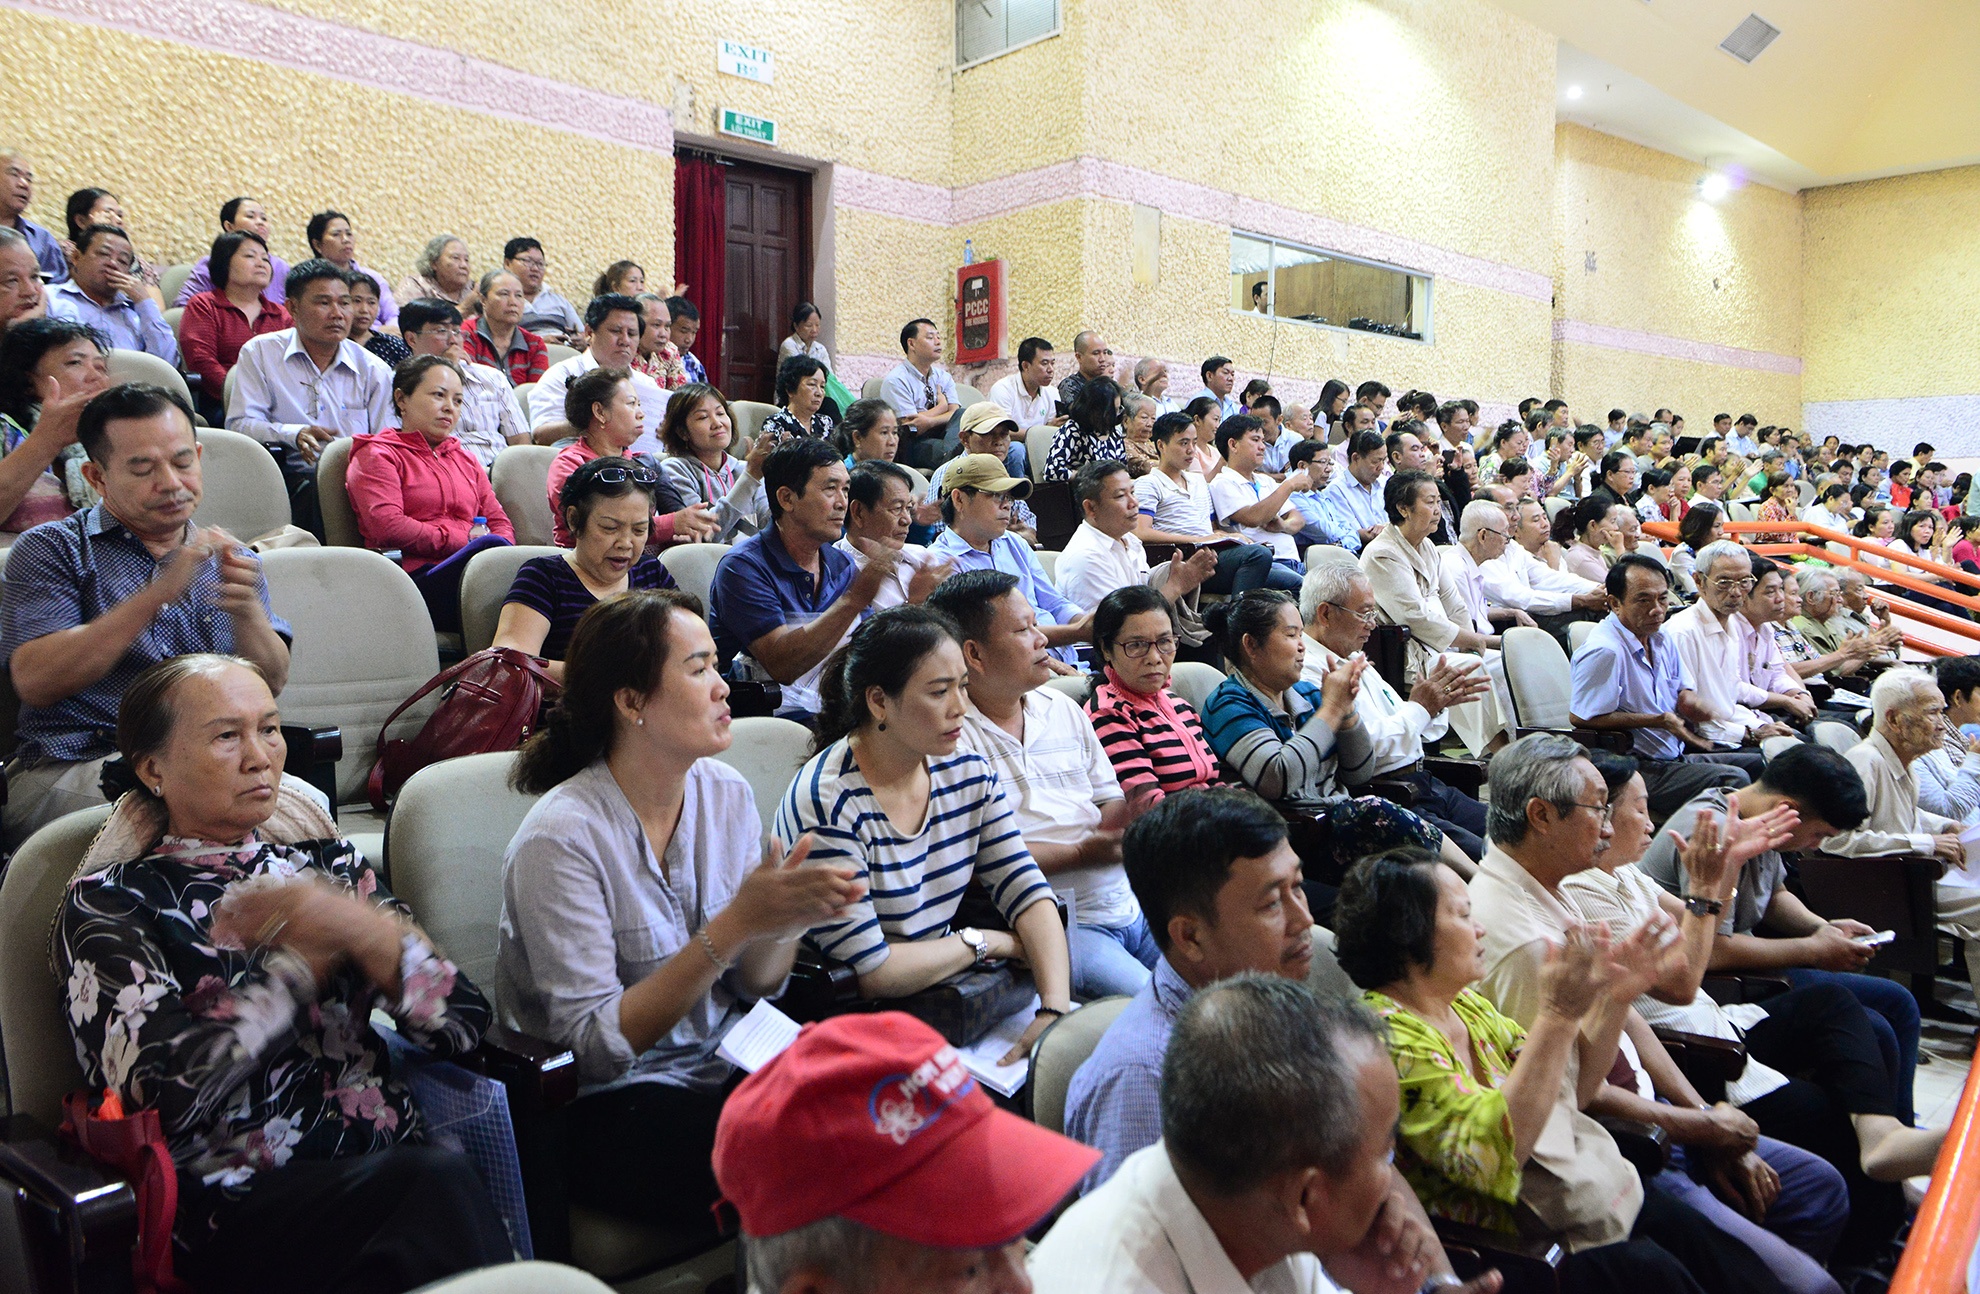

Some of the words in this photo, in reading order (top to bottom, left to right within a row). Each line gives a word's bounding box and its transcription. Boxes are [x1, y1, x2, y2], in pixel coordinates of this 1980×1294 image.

[725, 42, 771, 63] EXIT
[735, 114, 764, 130] EXIT
[965, 299, 988, 317] PCCC
